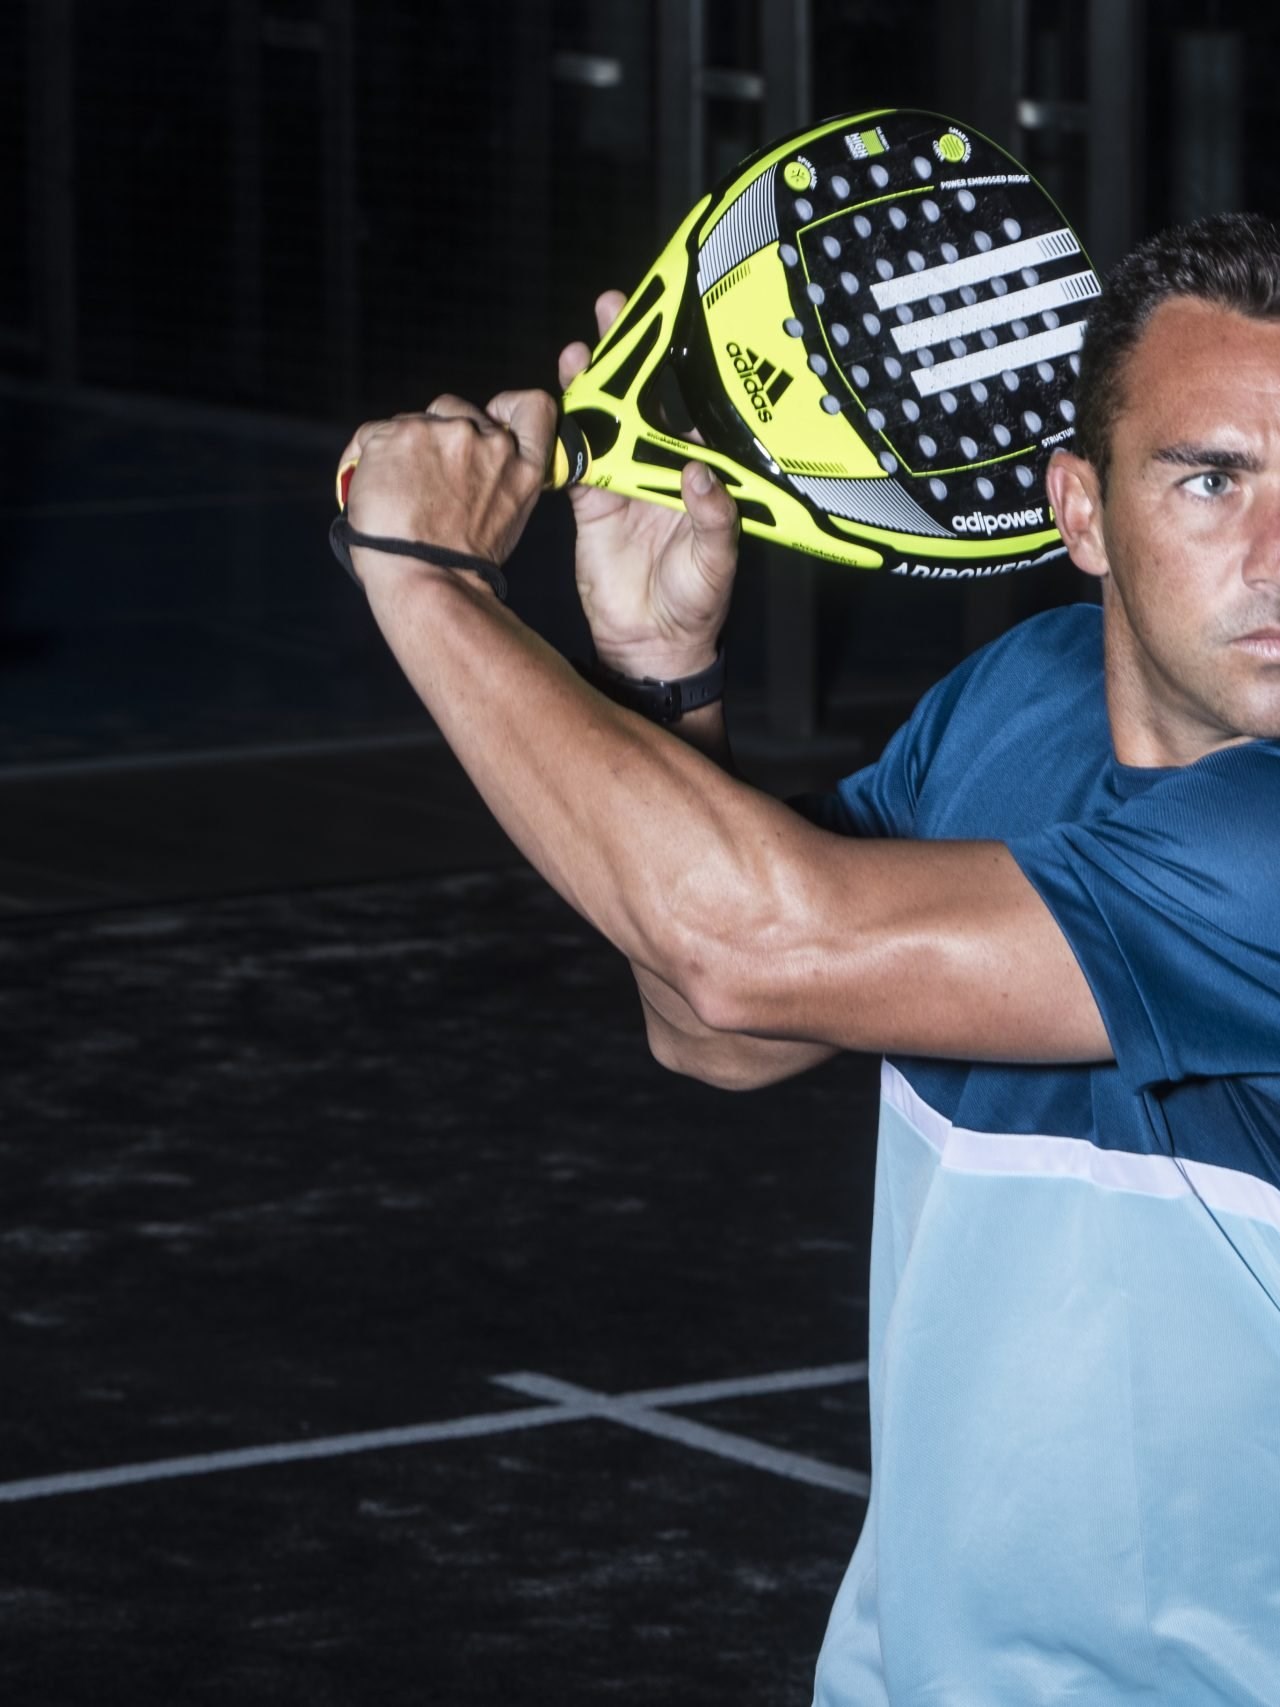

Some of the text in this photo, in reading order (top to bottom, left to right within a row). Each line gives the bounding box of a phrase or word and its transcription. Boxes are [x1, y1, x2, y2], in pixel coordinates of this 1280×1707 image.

[850, 131, 869, 158] HIGH
[941, 174, 1031, 191] POWER EMBOSSED RIDGE
[726, 342, 773, 423] adidas
[1042, 427, 1075, 448] STRUCTUR
[952, 507, 1044, 536] adipower
